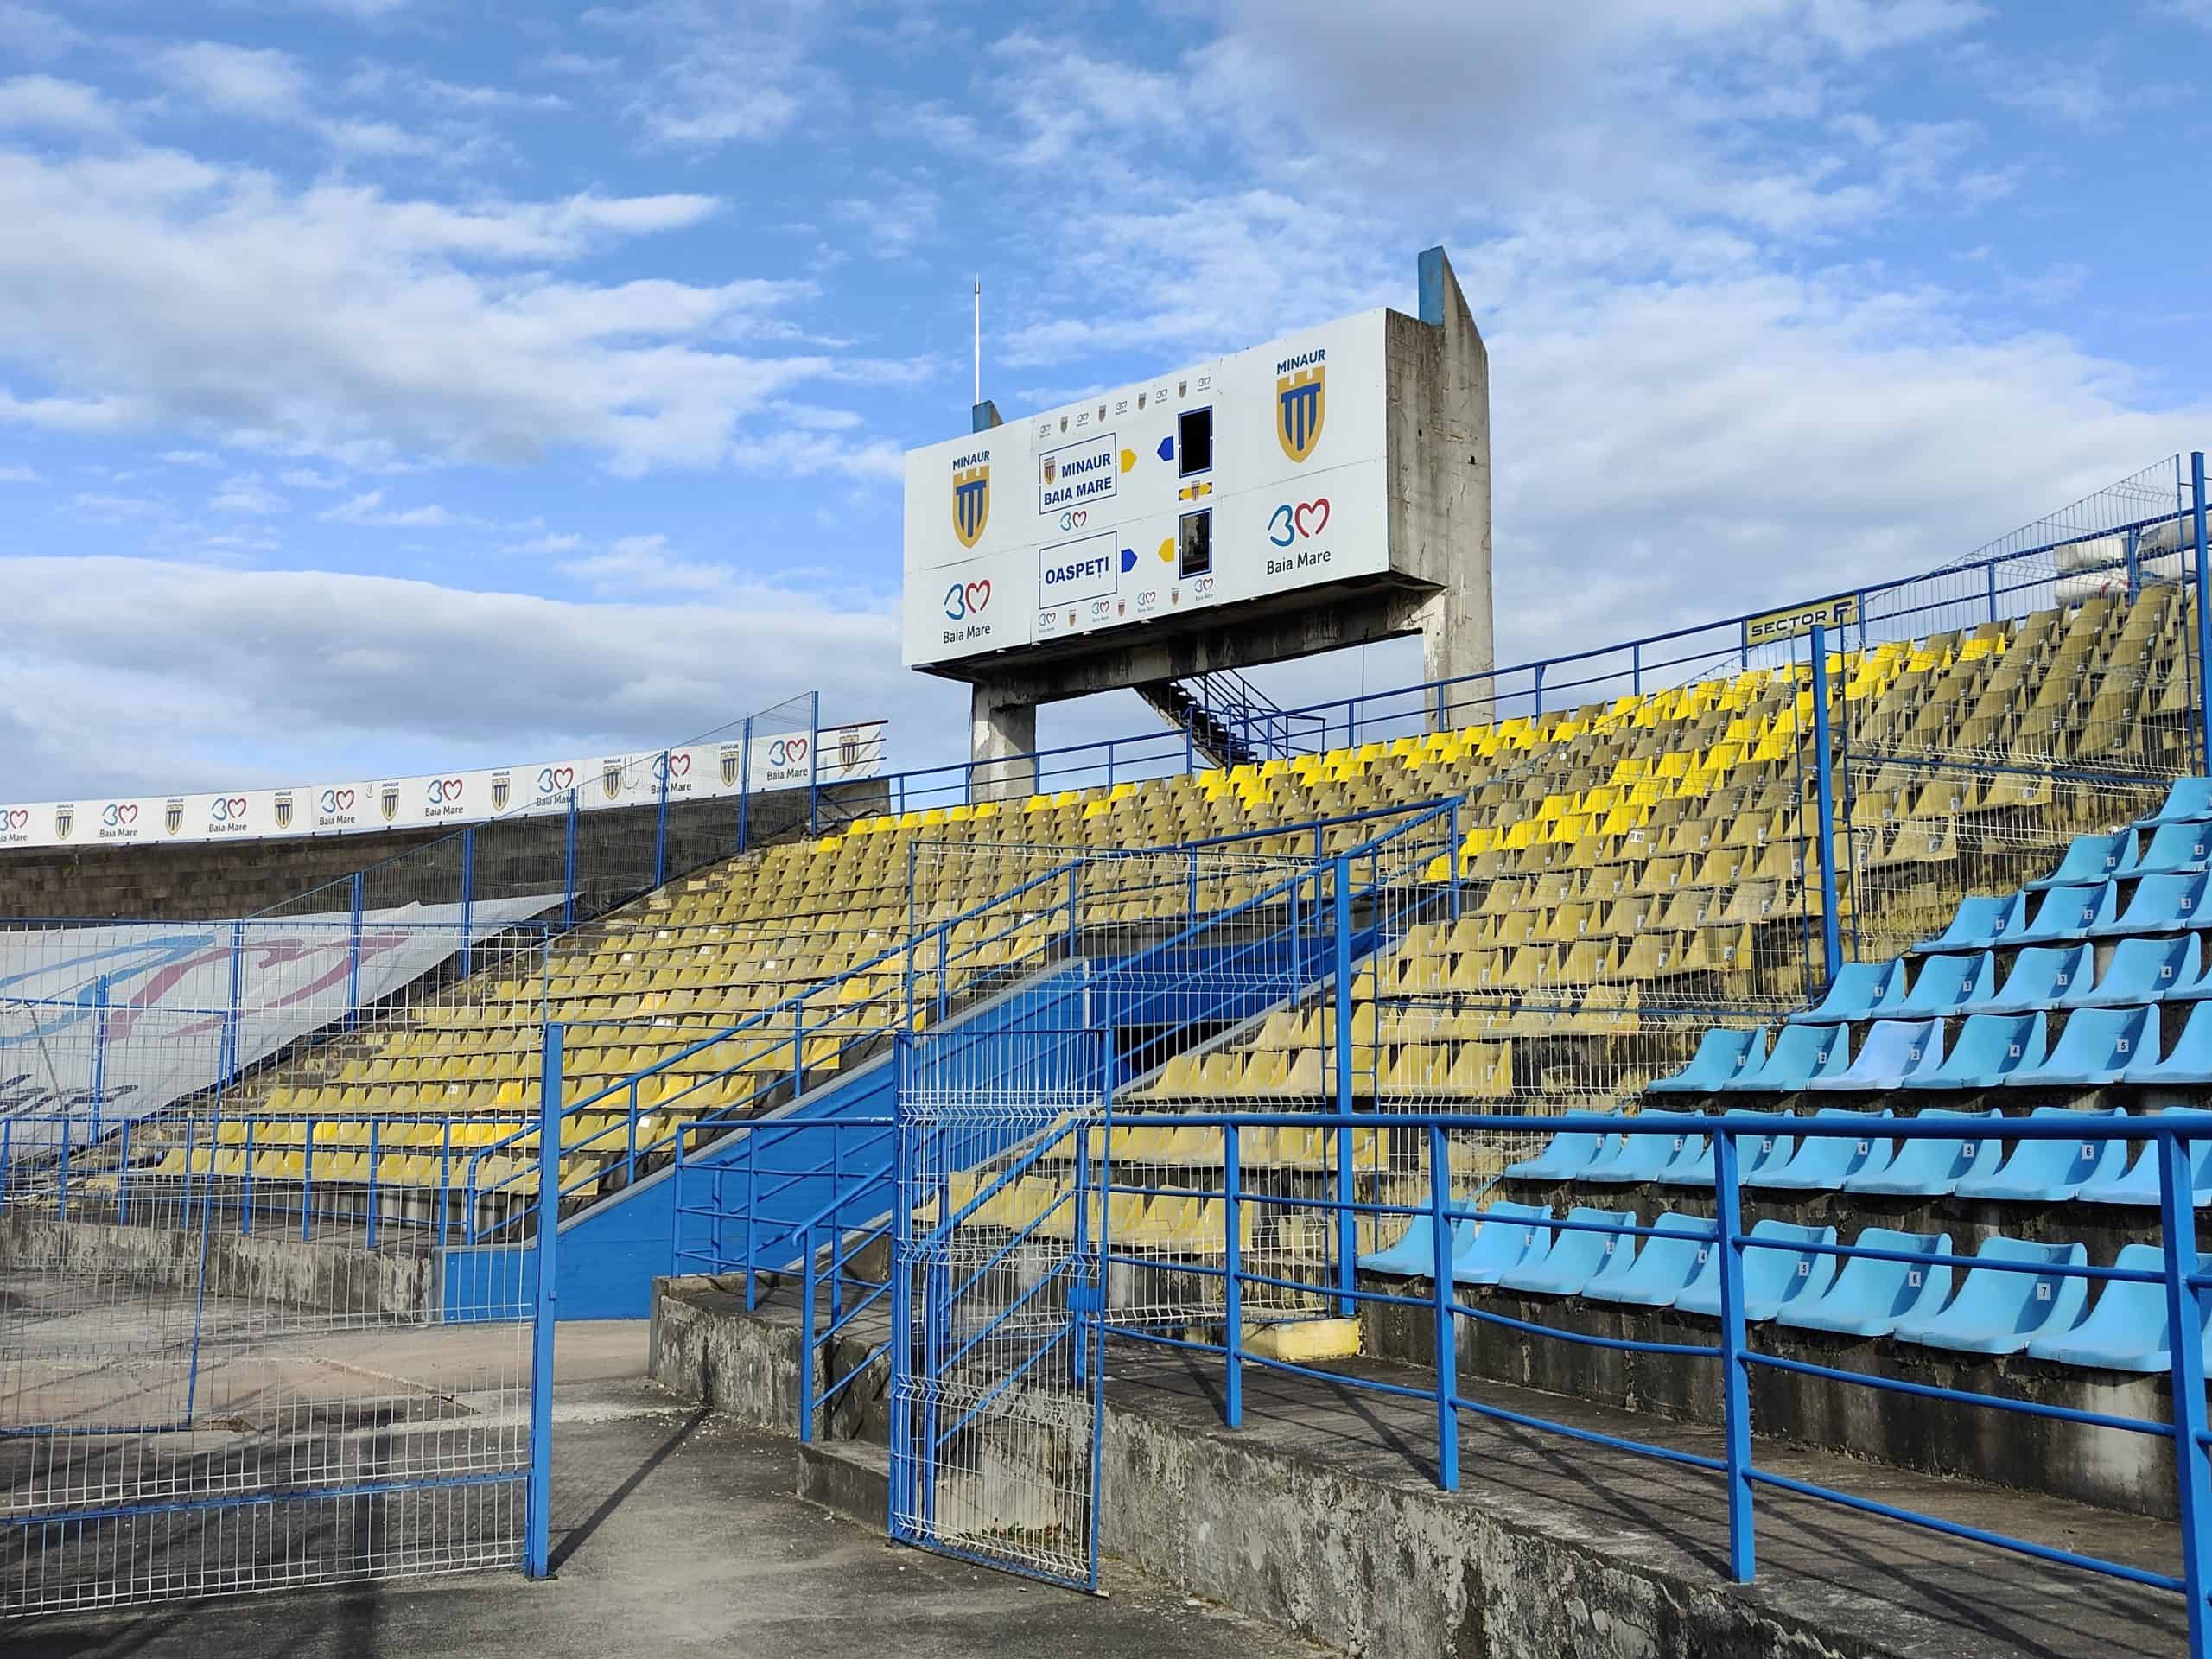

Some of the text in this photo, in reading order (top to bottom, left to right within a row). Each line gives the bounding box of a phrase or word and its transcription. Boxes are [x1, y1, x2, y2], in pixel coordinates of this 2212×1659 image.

[1277, 349, 1325, 375] MINAUR
[953, 450, 990, 470] MINAUR
[1062, 453, 1111, 478] MINAUR
[1044, 476, 1112, 505] BAIA MARE
[1267, 550, 1331, 575] Baia Mare
[1751, 601, 1852, 637] SECTOR F
[943, 625, 991, 644] Baia Mare
[767, 768, 808, 781] Baia Mare
[671, 782, 692, 792] Mare
[425, 805, 463, 817] Baia Mare
[209, 823, 247, 833] Baia Mare
[319, 815, 355, 825] Baia Mare
[9, 833, 28, 842] Mare
[99, 829, 138, 838] Baia Mare
